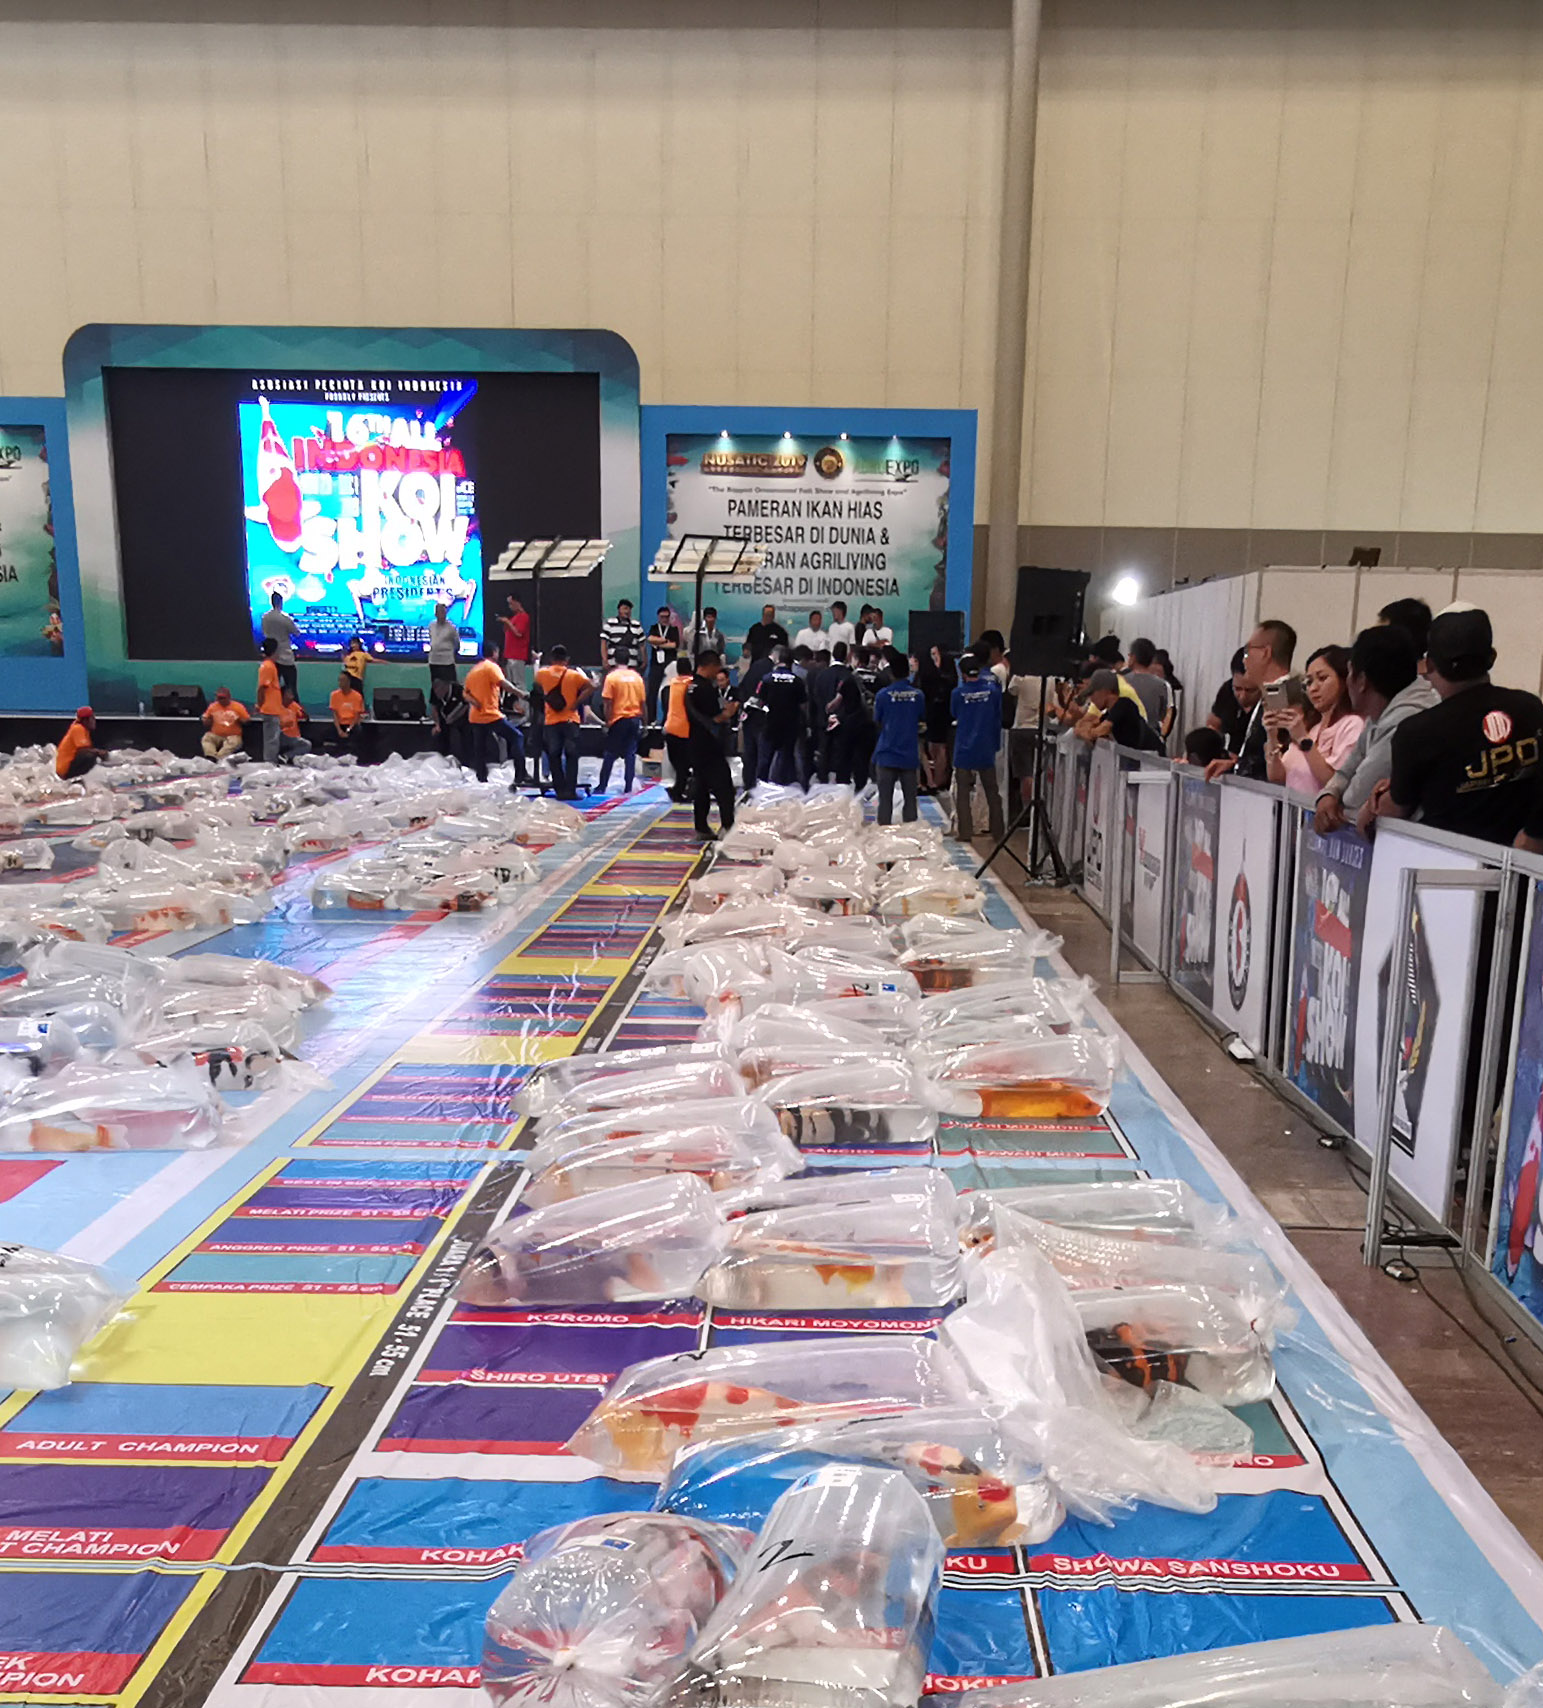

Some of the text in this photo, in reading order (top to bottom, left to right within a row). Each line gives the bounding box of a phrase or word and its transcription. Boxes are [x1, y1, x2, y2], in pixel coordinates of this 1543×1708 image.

[326, 410, 443, 451] 16TH ALL
[292, 436, 467, 477] INDONESIA
[885, 459, 920, 475] EXPO
[360, 469, 457, 523] KOI
[727, 499, 884, 519] PAMERAN IKAN HIAS
[298, 515, 470, 573] SHOW
[723, 525, 890, 545] TERBESAR DI DUNIA &
[800, 552, 887, 571] AGRILIVING
[798, 577, 815, 595] DI
[816, 578, 900, 596] INDONESIA
[168, 1283, 246, 1291] CEMPAKA
[526, 1313, 630, 1323] KOROMO
[730, 1316, 806, 1327] HIKARI
[368, 1358, 396, 1377] cm
[469, 1368, 548, 1384] SHIRO
[15, 1439, 260, 1455] ADULT CHAMPION
[5, 1529, 114, 1543] MELATI
[21, 1541, 182, 1556] CHAMPION
[421, 1544, 525, 1564] KOHAK
[1052, 1554, 1341, 1578] SHOWA SANSHOKU
